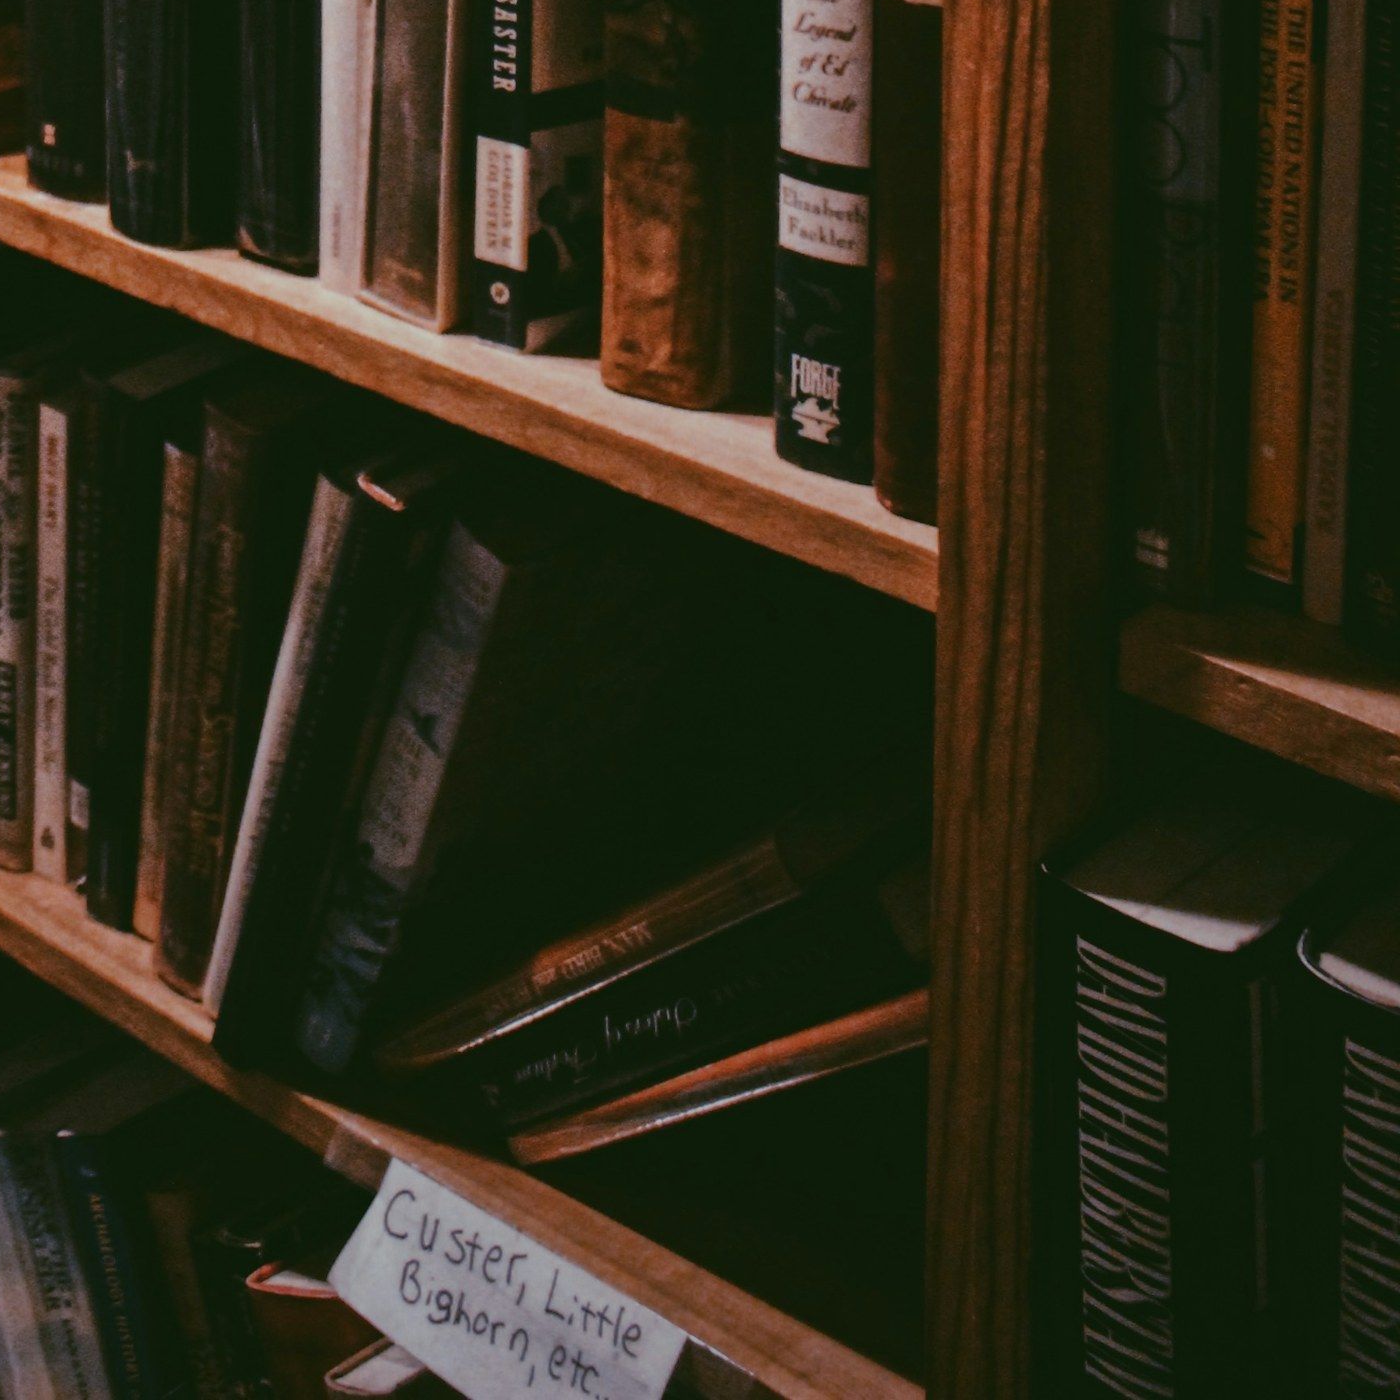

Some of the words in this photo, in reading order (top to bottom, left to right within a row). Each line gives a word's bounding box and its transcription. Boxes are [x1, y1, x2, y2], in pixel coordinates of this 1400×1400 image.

[1288, 7, 1307, 53] THE
[1285, 60, 1306, 155] UNITED
[1280, 163, 1301, 270] NATIONS
[1280, 276, 1298, 301] IN
[790, 352, 842, 411] FORGE
[1074, 934, 1169, 1101] DAVID
[383, 1189, 528, 1307] Custer,
[543, 1267, 643, 1359] Little
[399, 1258, 536, 1388] Bighorn,
[548, 1343, 609, 1400] etc.
